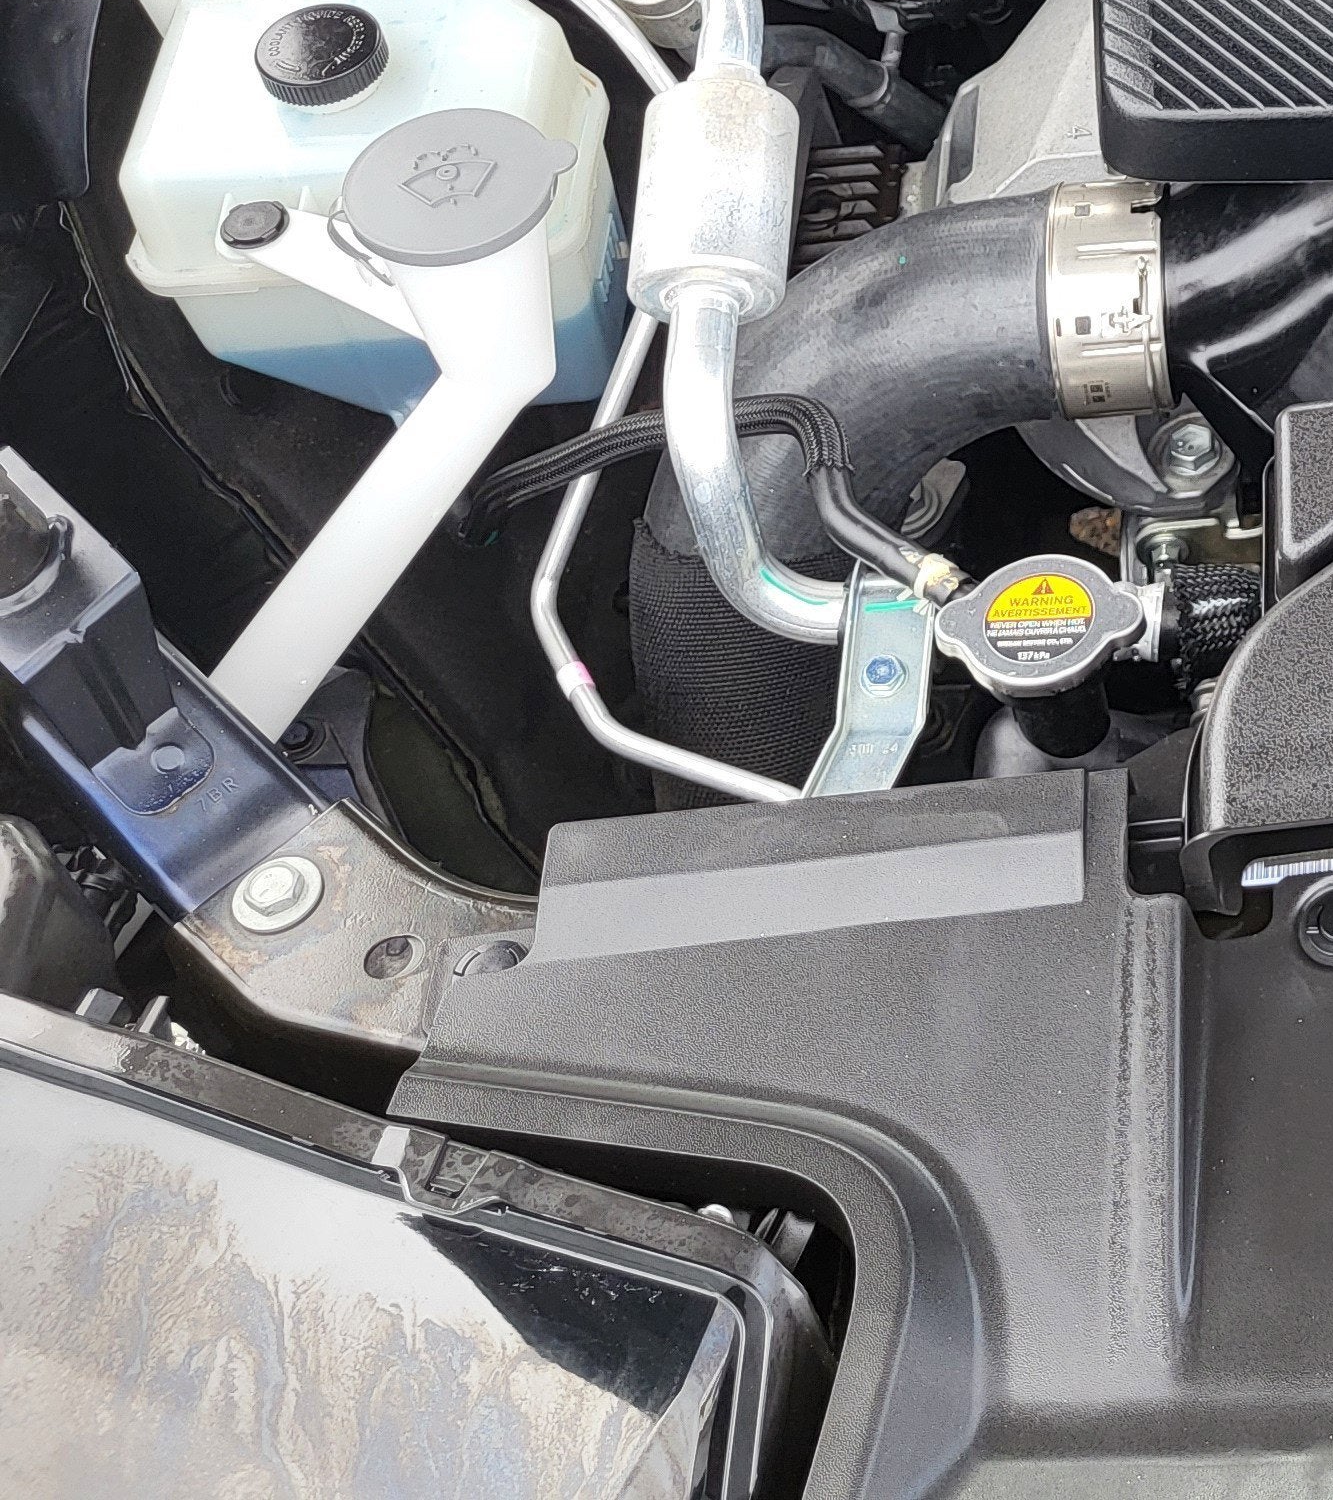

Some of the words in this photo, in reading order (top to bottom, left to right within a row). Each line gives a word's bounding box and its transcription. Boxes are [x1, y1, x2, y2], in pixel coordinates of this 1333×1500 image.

[268, 21, 295, 57] COOLANT
[1010, 595, 1074, 607] WARNING
[993, 605, 1087, 618] AVERTISSEMENT
